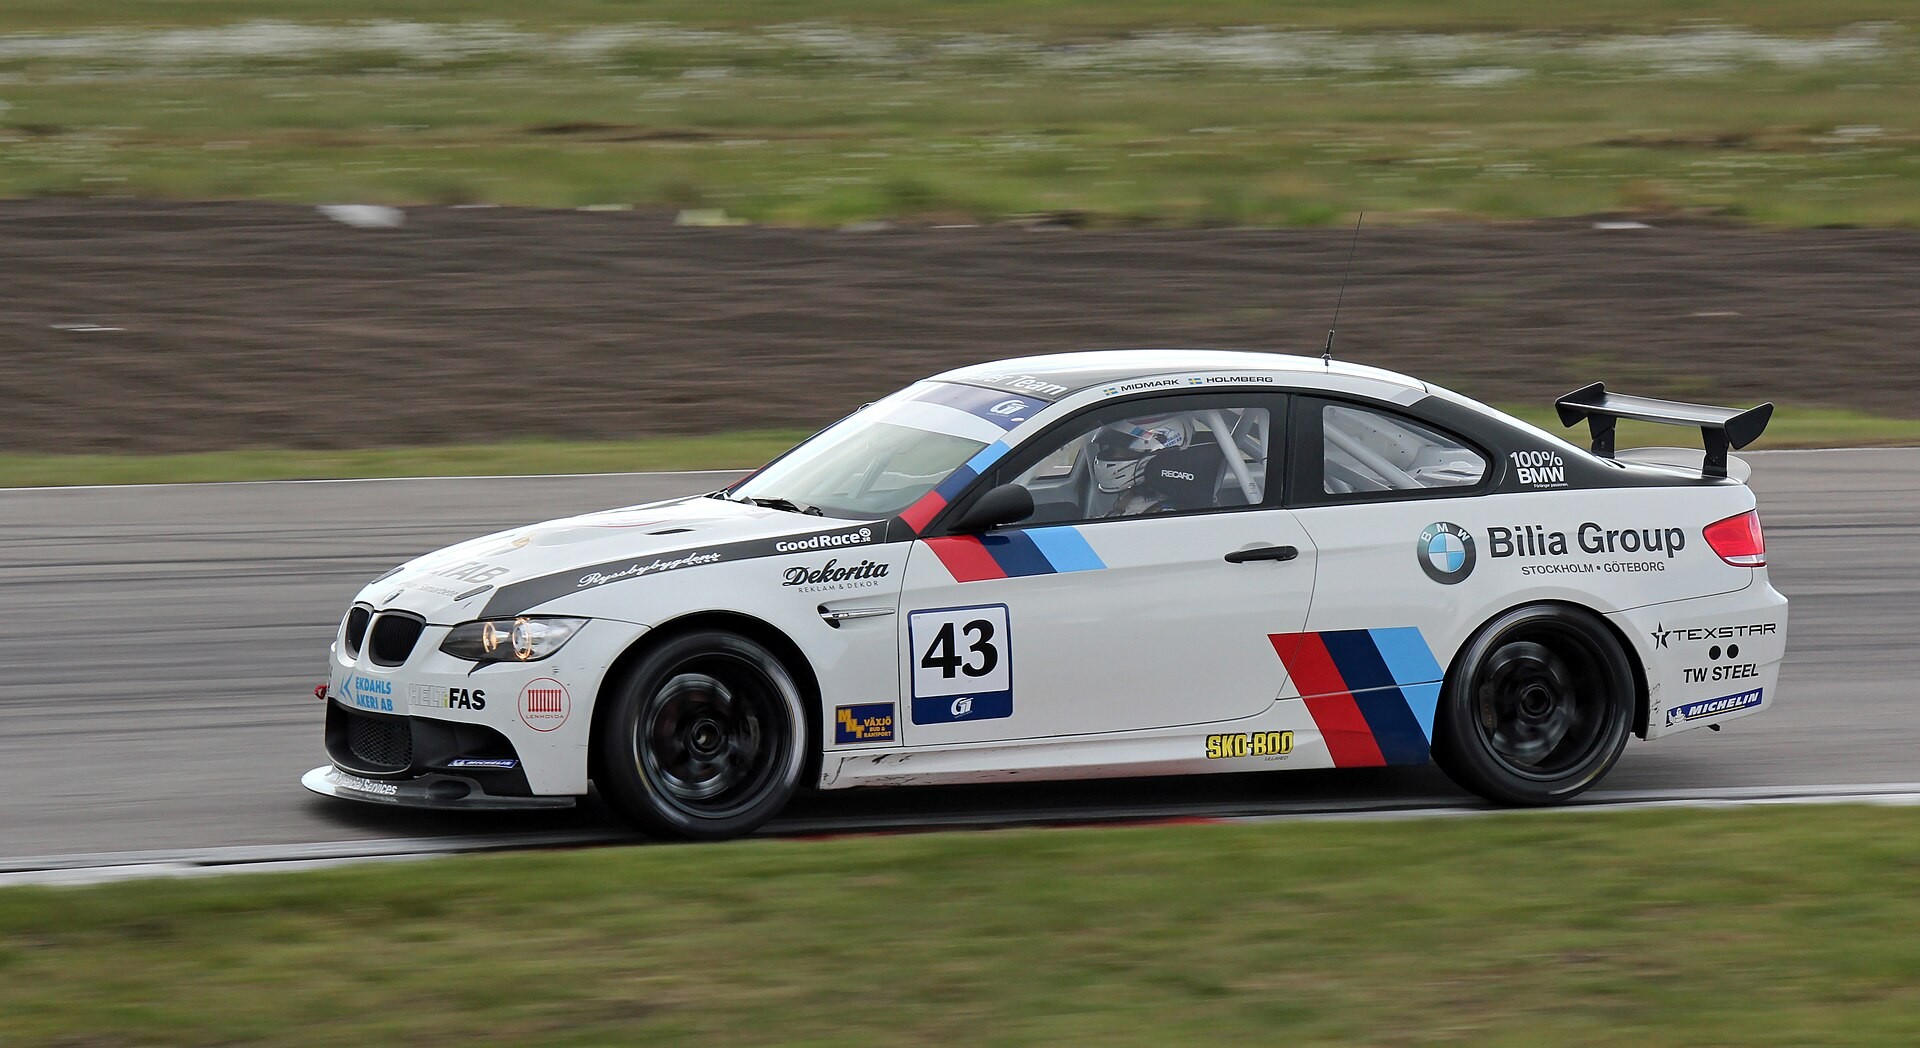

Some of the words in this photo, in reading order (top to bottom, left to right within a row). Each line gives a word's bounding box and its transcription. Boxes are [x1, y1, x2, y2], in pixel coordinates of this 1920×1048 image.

[1006, 375, 1068, 395] Team
[1121, 379, 1180, 392] MIDMARK
[1510, 451, 1563, 467] 100%
[1161, 469, 1194, 481] RECARO
[1516, 466, 1564, 484] BMW
[1487, 524, 1568, 558] Bilia
[1577, 522, 1686, 559] Group
[782, 558, 889, 587] Dekorita
[1521, 565, 1594, 576] STOCKHOLM
[1603, 560, 1665, 573] GÖTEBORG
[798, 585, 836, 593] REKLAM
[847, 580, 879, 589] DEKOR
[1672, 623, 1777, 641] TEXSTAR
[921, 619, 999, 679] 43
[1683, 667, 1708, 683] TW
[1711, 663, 1759, 681] STEEL
[355, 676, 392, 695] EKDAHLS
[356, 690, 379, 709] ÅKERI
[380, 701, 394, 712] AB
[1688, 691, 1760, 716] MICHELIN
[864, 715, 892, 727] VÄXJÖ
[361, 779, 398, 795] Services
